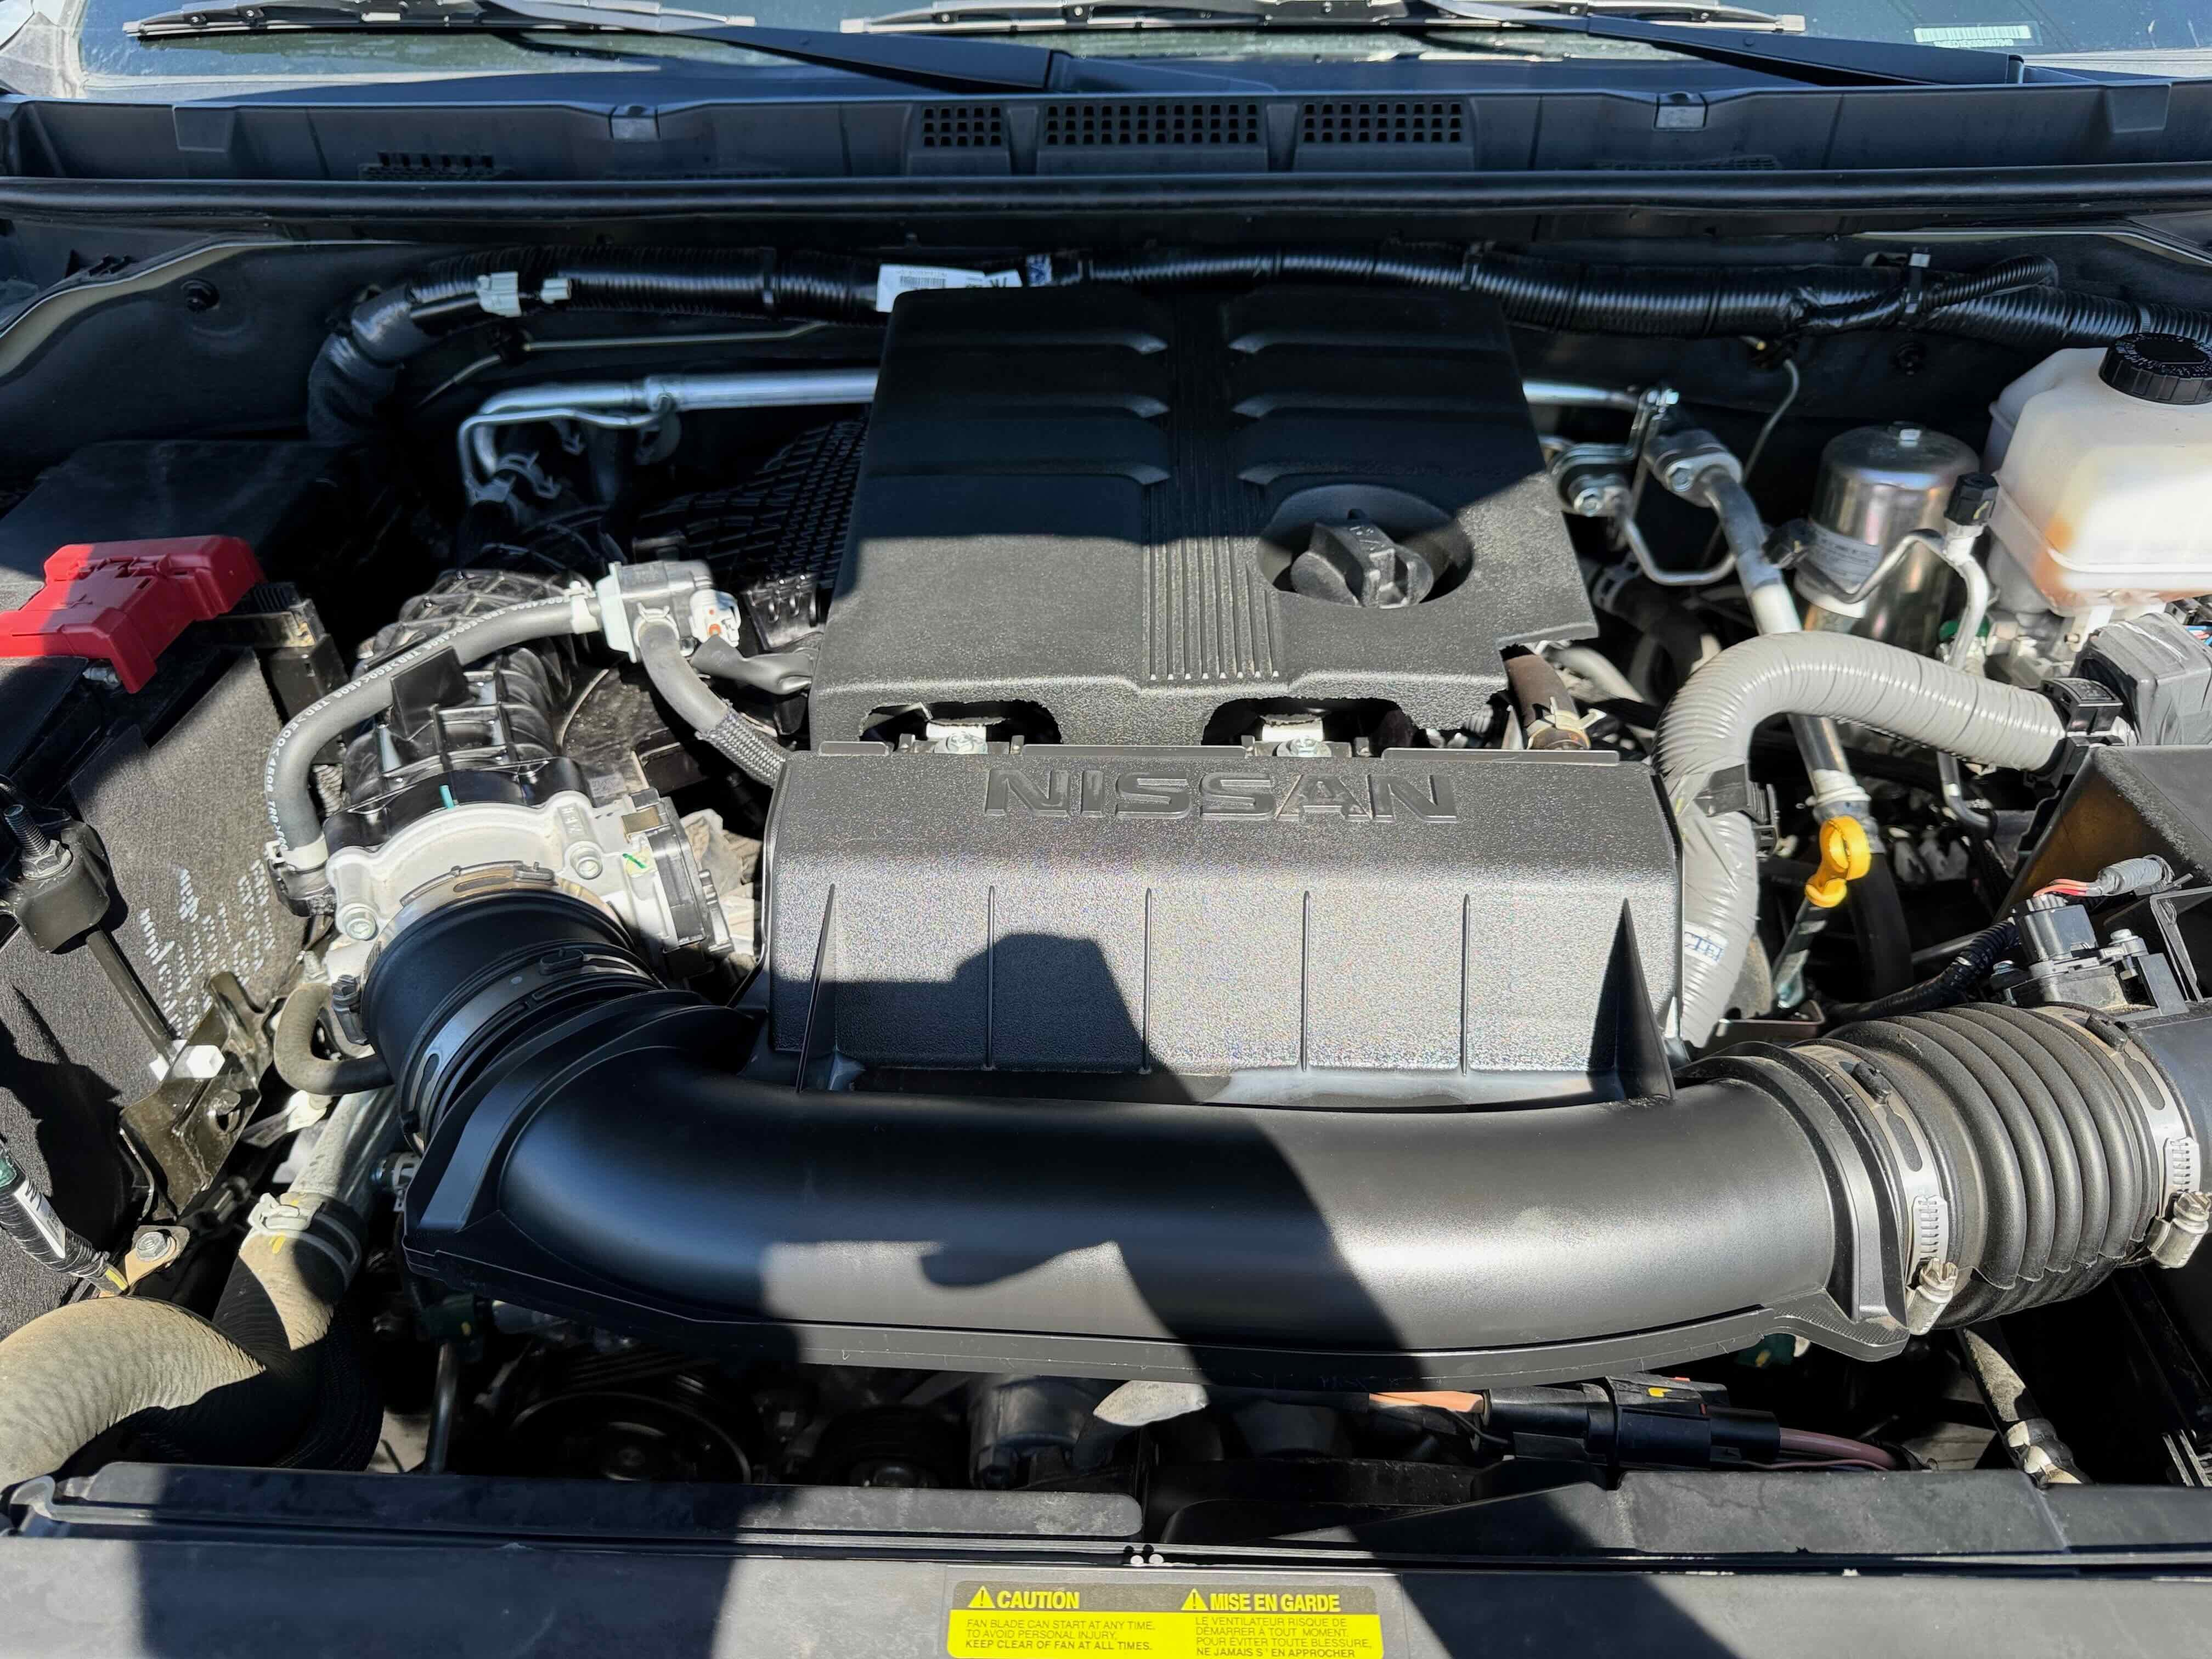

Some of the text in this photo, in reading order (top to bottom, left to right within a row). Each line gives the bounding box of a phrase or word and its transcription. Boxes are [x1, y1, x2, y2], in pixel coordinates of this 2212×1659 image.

[984, 769, 1458, 822] NISSAN
[997, 1590, 1080, 1609] CAUTION
[1210, 1593, 1341, 1612] MISE EN GARDE
[967, 1619, 987, 1628] FAN
[990, 1620, 1024, 1628] BLADE
[1027, 1620, 1049, 1629] CAN
[1052, 1621, 1086, 1629] START
[1100, 1621, 1125, 1629] ANY
[1195, 1617, 1347, 1627] LE VENTILATEUR RISQUE DE
[967, 1629, 980, 1638] TO
[983, 1630, 1015, 1639] AVOID
[1018, 1630, 1075, 1639] PERSONAL
[1268, 1628, 1295, 1637] TOUT
[966, 1640, 994, 1649] KEEP
[997, 1640, 1033, 1649] CLEAR
[1036, 1641, 1049, 1649] OF
[1078, 1641, 1090, 1650] AT
[1118, 1642, 1153, 1650] TIMES.
[1196, 1637, 1226, 1646] POUR
[1272, 1638, 1309, 1647] TOUTE
[1197, 1647, 1210, 1656] NE
[1214, 1647, 1252, 1656] JAMAIS
[1288, 1649, 1355, 1658] APPROCHER
